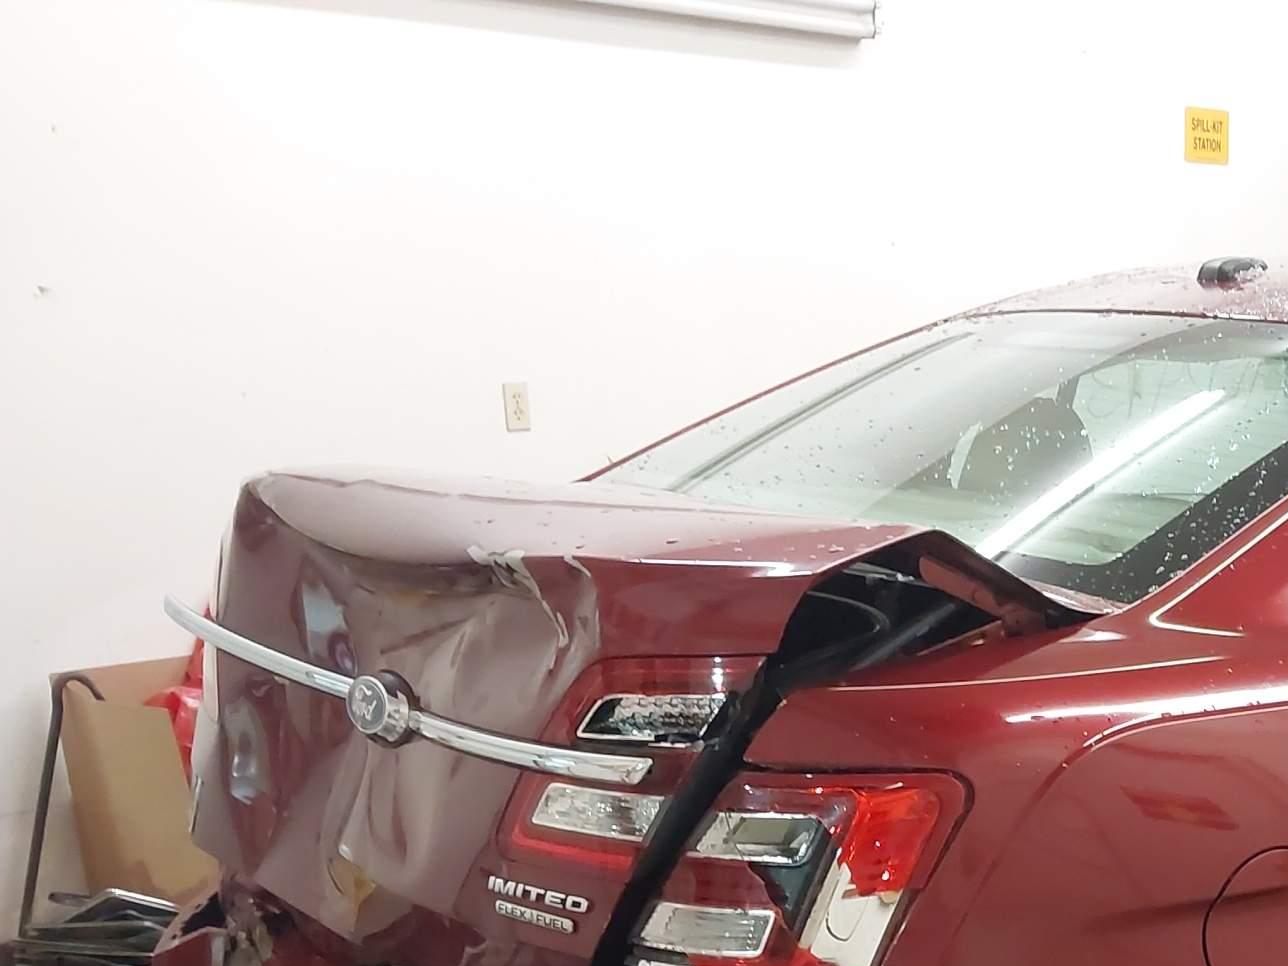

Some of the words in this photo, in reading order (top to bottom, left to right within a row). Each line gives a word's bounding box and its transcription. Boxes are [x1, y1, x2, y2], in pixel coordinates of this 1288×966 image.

[1193, 136, 1222, 152] STATION
[497, 902, 528, 920] FLEX
[536, 913, 569, 931] FUEL
